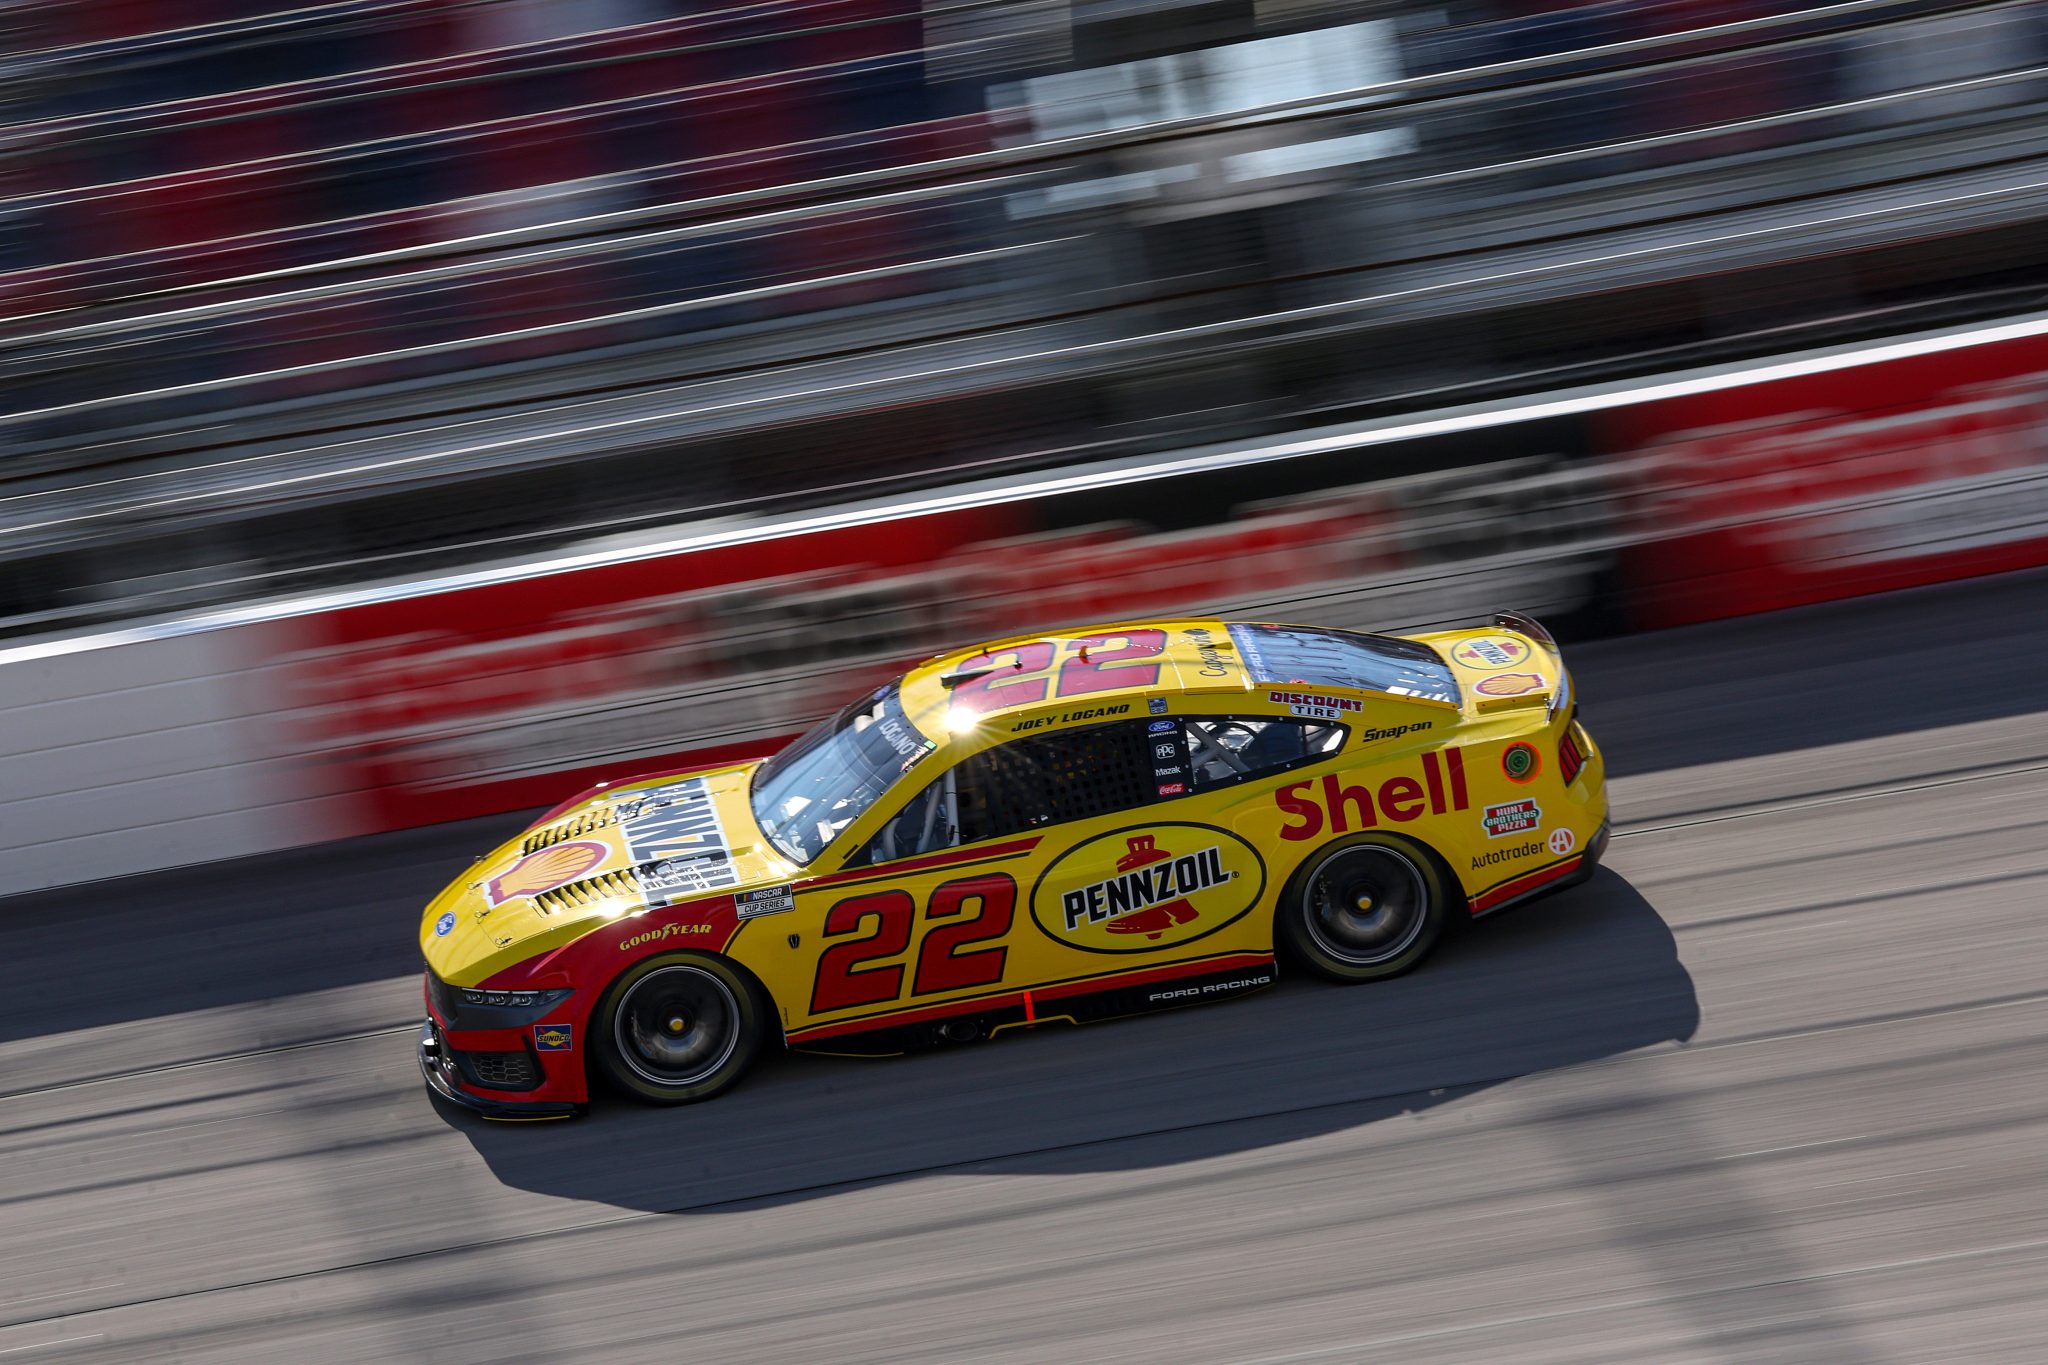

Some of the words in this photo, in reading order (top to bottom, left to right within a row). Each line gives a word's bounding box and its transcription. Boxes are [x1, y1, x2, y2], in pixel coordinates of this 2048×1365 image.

[1468, 640, 1514, 665] PENNZ
[948, 629, 1168, 714] 22
[1269, 691, 1363, 712] DISCOUNT
[1295, 705, 1336, 717] TIRE
[1011, 716, 1056, 732] JOEY
[1062, 704, 1130, 722] LOGANO
[880, 718, 917, 755] LOGANO
[1362, 721, 1432, 742] Snap-on
[1157, 745, 1175, 757] PPG
[1155, 766, 1181, 776] Mazak
[1275, 747, 1469, 841] Shell
[1486, 809, 1537, 826] BROTHERS
[1496, 804, 1525, 816] HUNT
[1498, 819, 1528, 832] PIZZA
[1471, 842, 1545, 870] Autotrader
[753, 887, 783, 900] NASCAR
[1062, 846, 1232, 931] PENNZOIL
[744, 903, 760, 913] CUP
[760, 899, 785, 911] SERIES
[619, 922, 712, 951] GOODYEAR
[808, 872, 1018, 1015] 22
[1149, 987, 1200, 1001] FORD
[1203, 976, 1271, 993] RACING
[537, 1033, 571, 1043] SUNOCO
